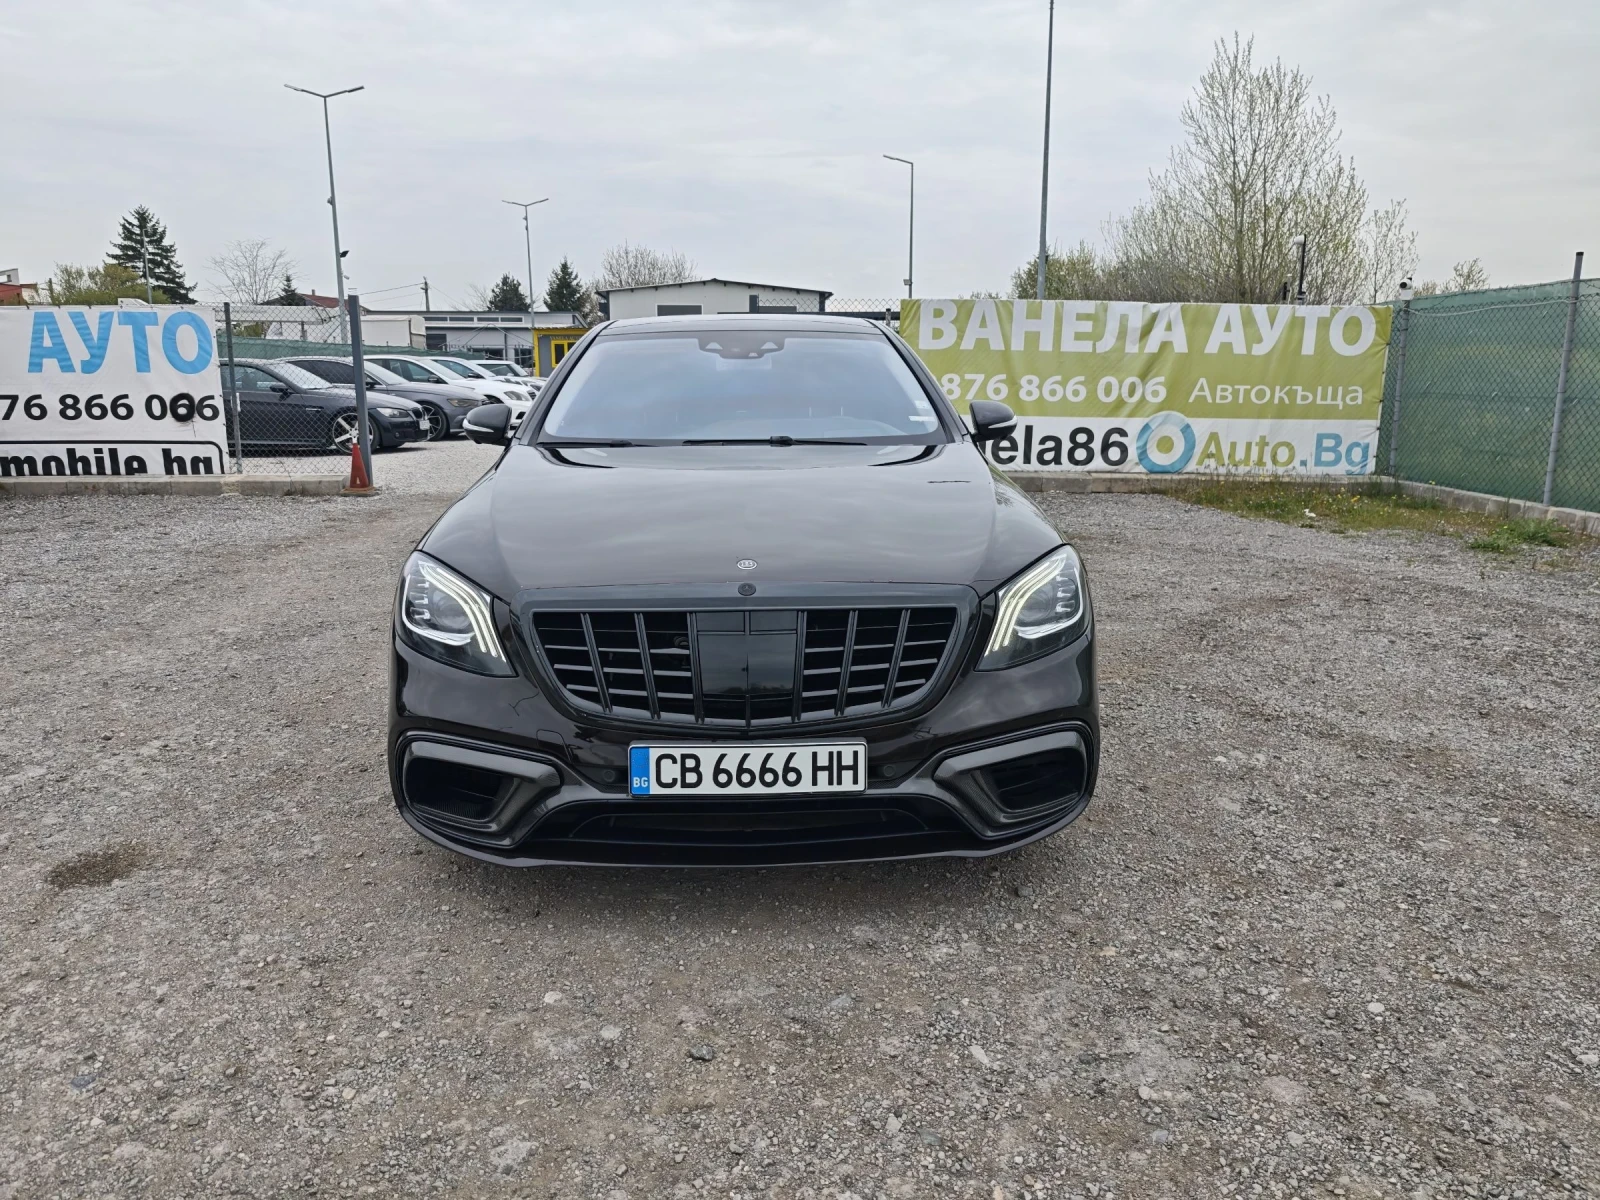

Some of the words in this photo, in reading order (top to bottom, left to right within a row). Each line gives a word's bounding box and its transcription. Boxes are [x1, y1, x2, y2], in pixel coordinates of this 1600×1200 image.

[28, 311, 213, 374] АУТО
[918, 301, 1188, 354] ВАНЕЛА
[1203, 304, 1377, 356] АУТО
[932, 373, 1009, 401] 876
[1018, 375, 1087, 402] 866
[1097, 376, 1167, 403] 006
[1188, 377, 1363, 409] Автокъща
[58, 393, 135, 421] 866
[1195, 432, 1370, 475] Auto.Bg
[633, 777, 649, 788] BG
[655, 753, 703, 788] CB
[712, 752, 803, 788] 6666
[811, 750, 859, 786] HH
